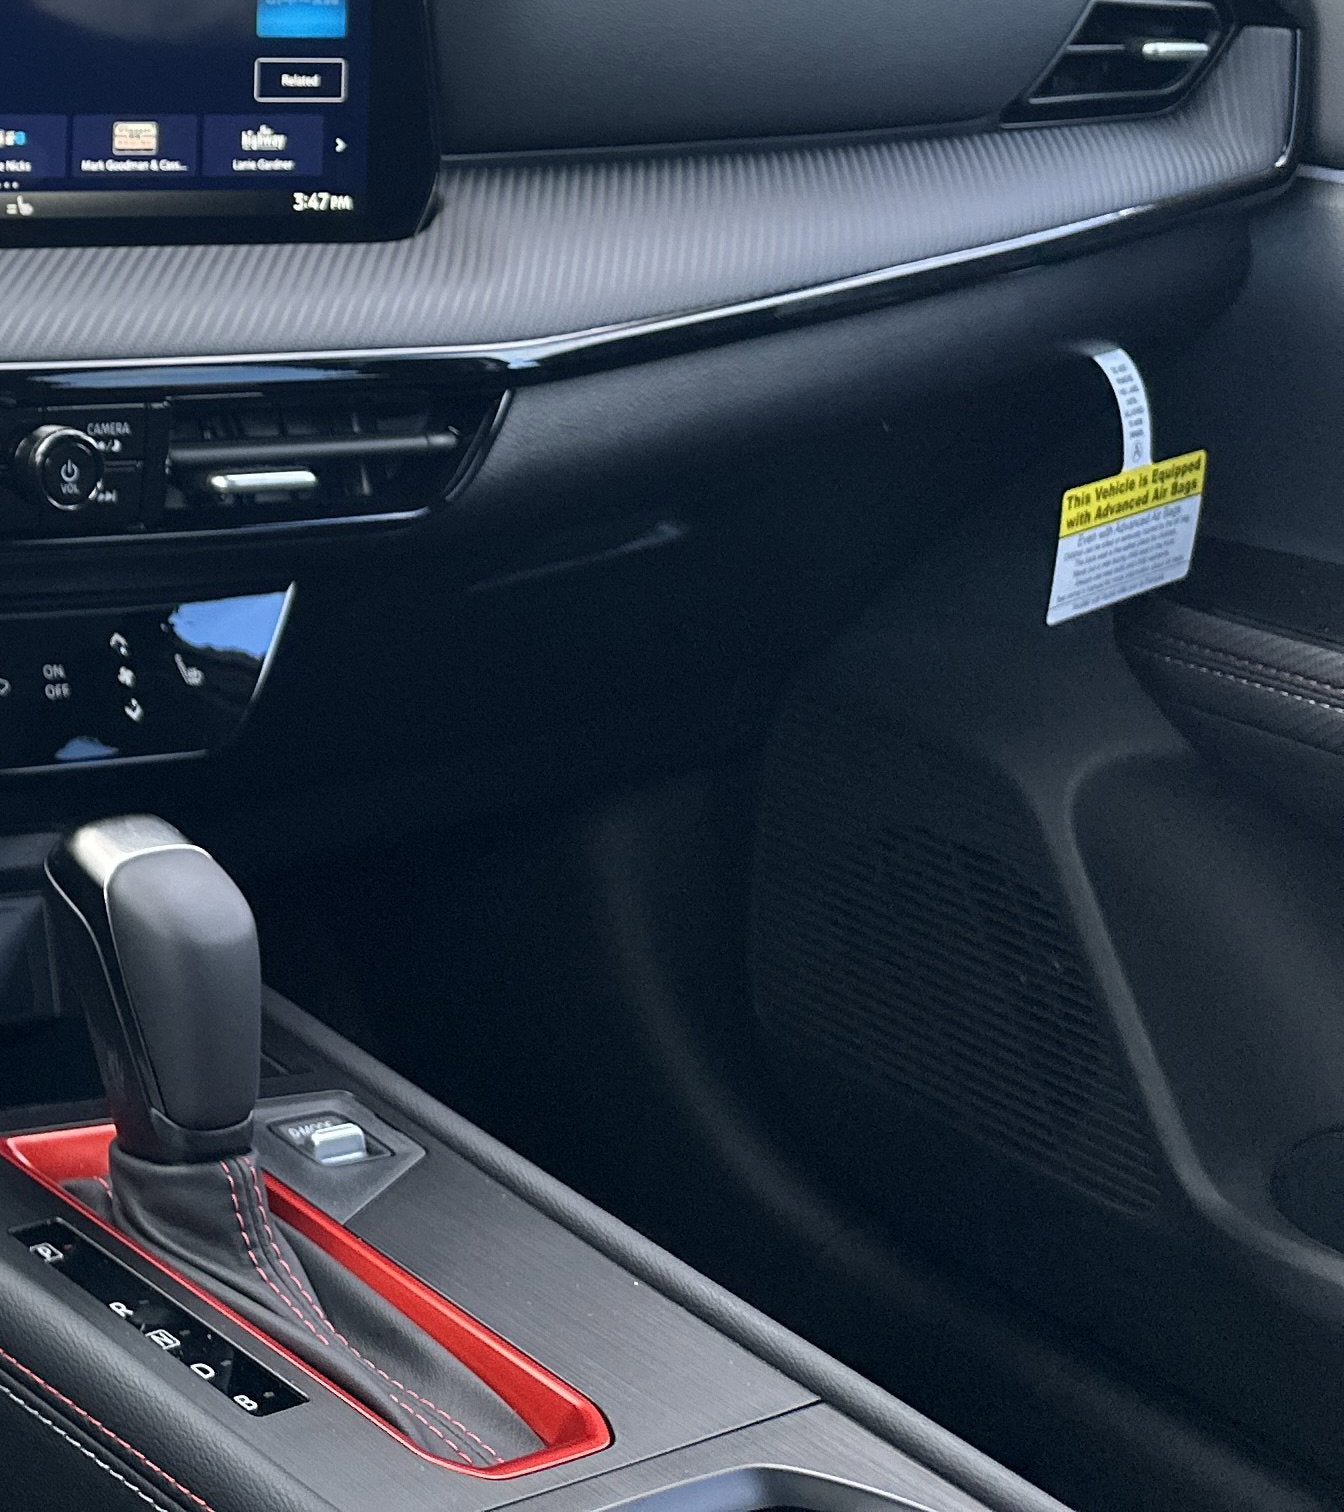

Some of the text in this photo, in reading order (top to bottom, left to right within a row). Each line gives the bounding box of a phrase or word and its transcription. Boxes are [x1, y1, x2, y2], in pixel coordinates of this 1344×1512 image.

[292, 191, 354, 212] 3:47 PM
[86, 421, 131, 436] CAMERA
[60, 482, 81, 495] VOL
[1067, 455, 1202, 511] This Vehicle is Equipped
[1066, 477, 1198, 529] with Advanced Air Bags
[42, 663, 66, 680] ON
[44, 682, 70, 700] OFF
[109, 1300, 134, 1318] R
[190, 1363, 216, 1381] D
[232, 1393, 259, 1412] B
